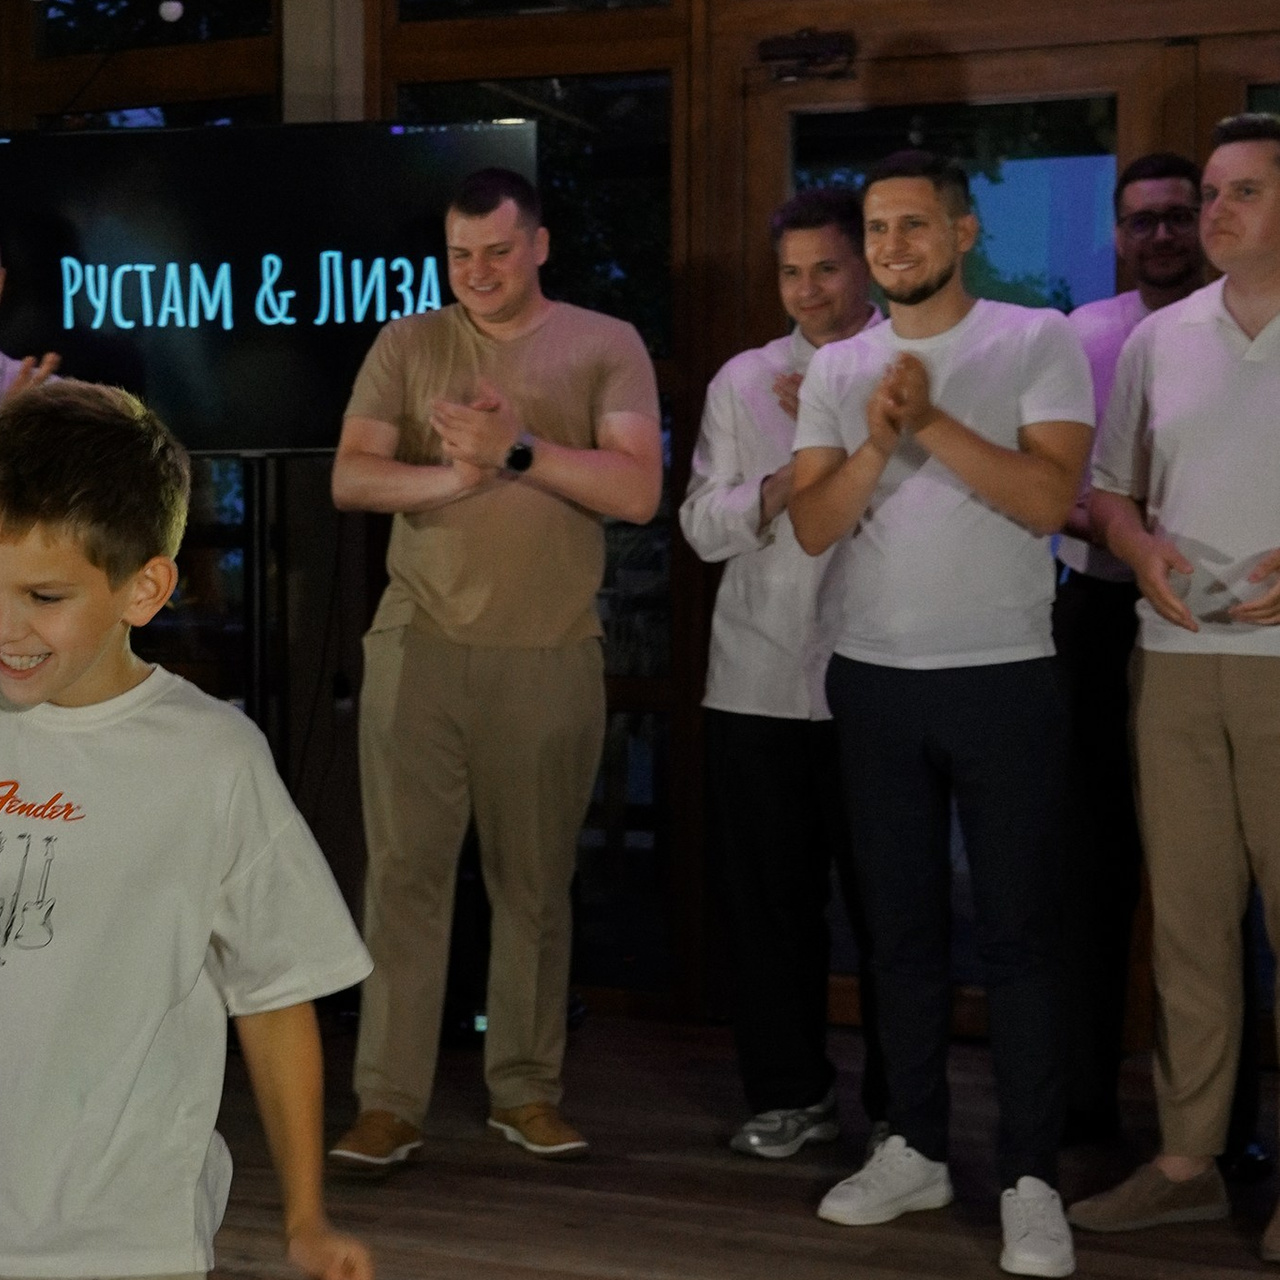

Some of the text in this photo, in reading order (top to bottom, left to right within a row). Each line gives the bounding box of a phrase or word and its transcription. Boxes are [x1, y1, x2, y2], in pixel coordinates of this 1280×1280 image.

[60, 250, 442, 330] РУСТАМ & ЛИЗА
